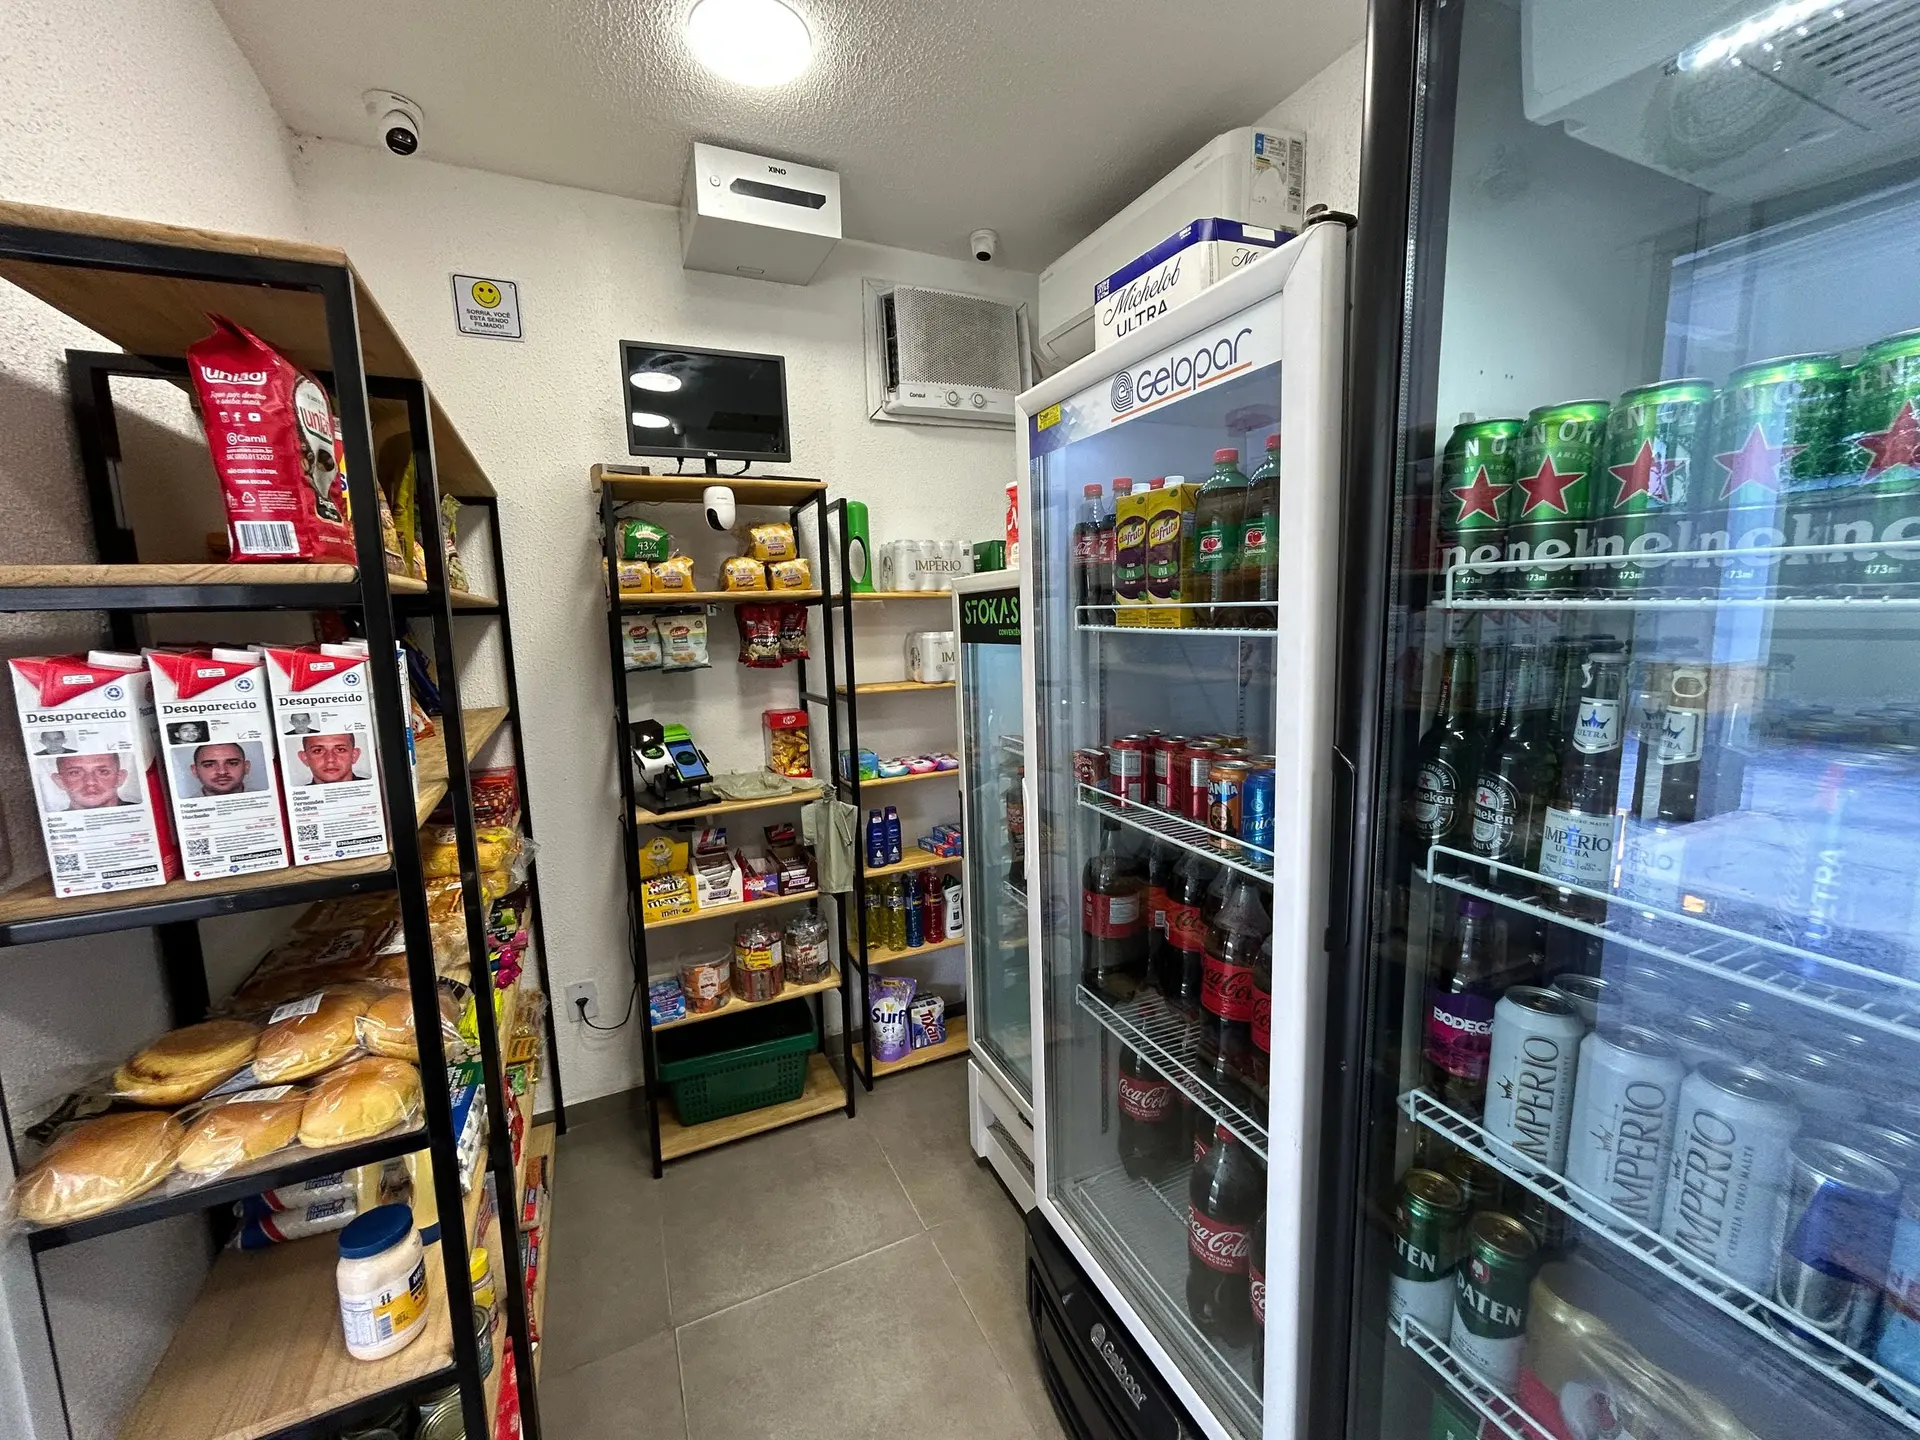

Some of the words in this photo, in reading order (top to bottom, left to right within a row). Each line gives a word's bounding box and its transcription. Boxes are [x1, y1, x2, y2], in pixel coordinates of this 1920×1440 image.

[1103, 256, 1181, 326] Michelob
[466, 308, 492, 316] SORRIA,
[1116, 299, 1168, 338] ULTRA
[474, 321, 505, 329] FILMADO!
[1137, 327, 1252, 402] Gelopar
[238, 434, 267, 443] Camil
[1118, 527, 1144, 544] dafruta
[1150, 521, 1178, 540] dafruta
[637, 541, 657, 550] 43%
[914, 559, 961, 571] IMPERIO
[1618, 571, 1645, 580] 473ml
[964, 596, 1019, 624] STOKAS
[162, 700, 257, 715] Desaparecido
[279, 693, 363, 707] Desaparecido
[26, 709, 127, 724] Desaparecido
[1577, 729, 1608, 740] ULTRA
[1427, 762, 1450, 787] ORIGINAL
[1486, 779, 1510, 805] ORIGINAL
[1556, 845, 1589, 858] ULTRA
[872, 1007, 907, 1025] Surf
[1512, 1036, 1559, 1166] IMPERIO
[1611, 1081, 1666, 1223] IMPERIO
[1673, 1108, 1736, 1266] IMPERIO
